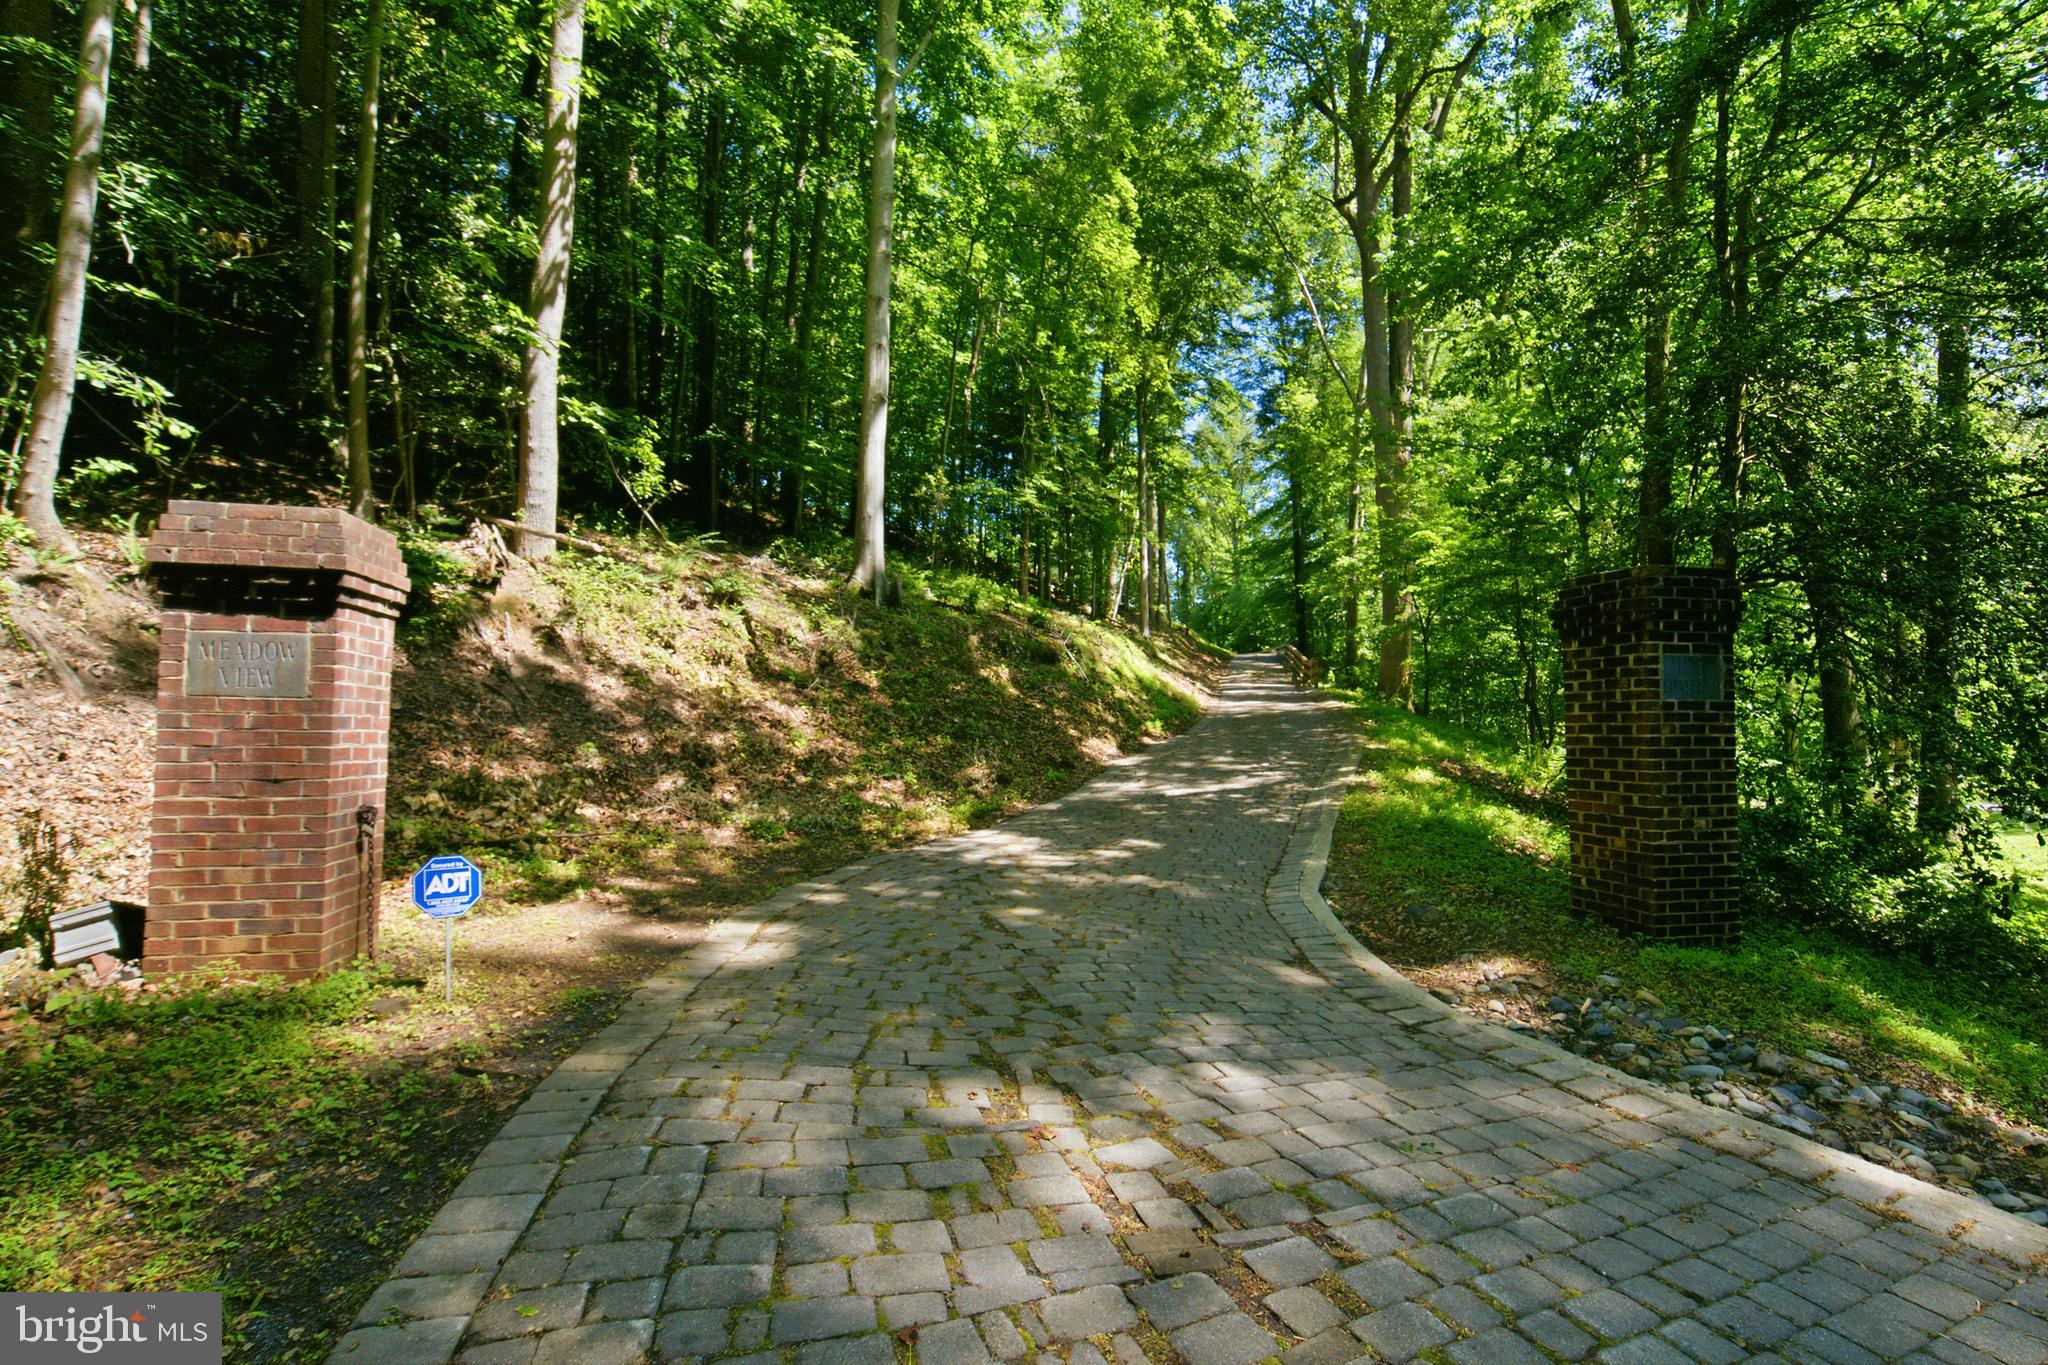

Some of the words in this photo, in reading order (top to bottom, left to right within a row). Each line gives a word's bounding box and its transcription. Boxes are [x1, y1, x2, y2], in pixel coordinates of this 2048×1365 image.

[199, 640, 299, 662] MEADOW
[219, 667, 278, 688] VIEW
[425, 871, 470, 896] ADT
